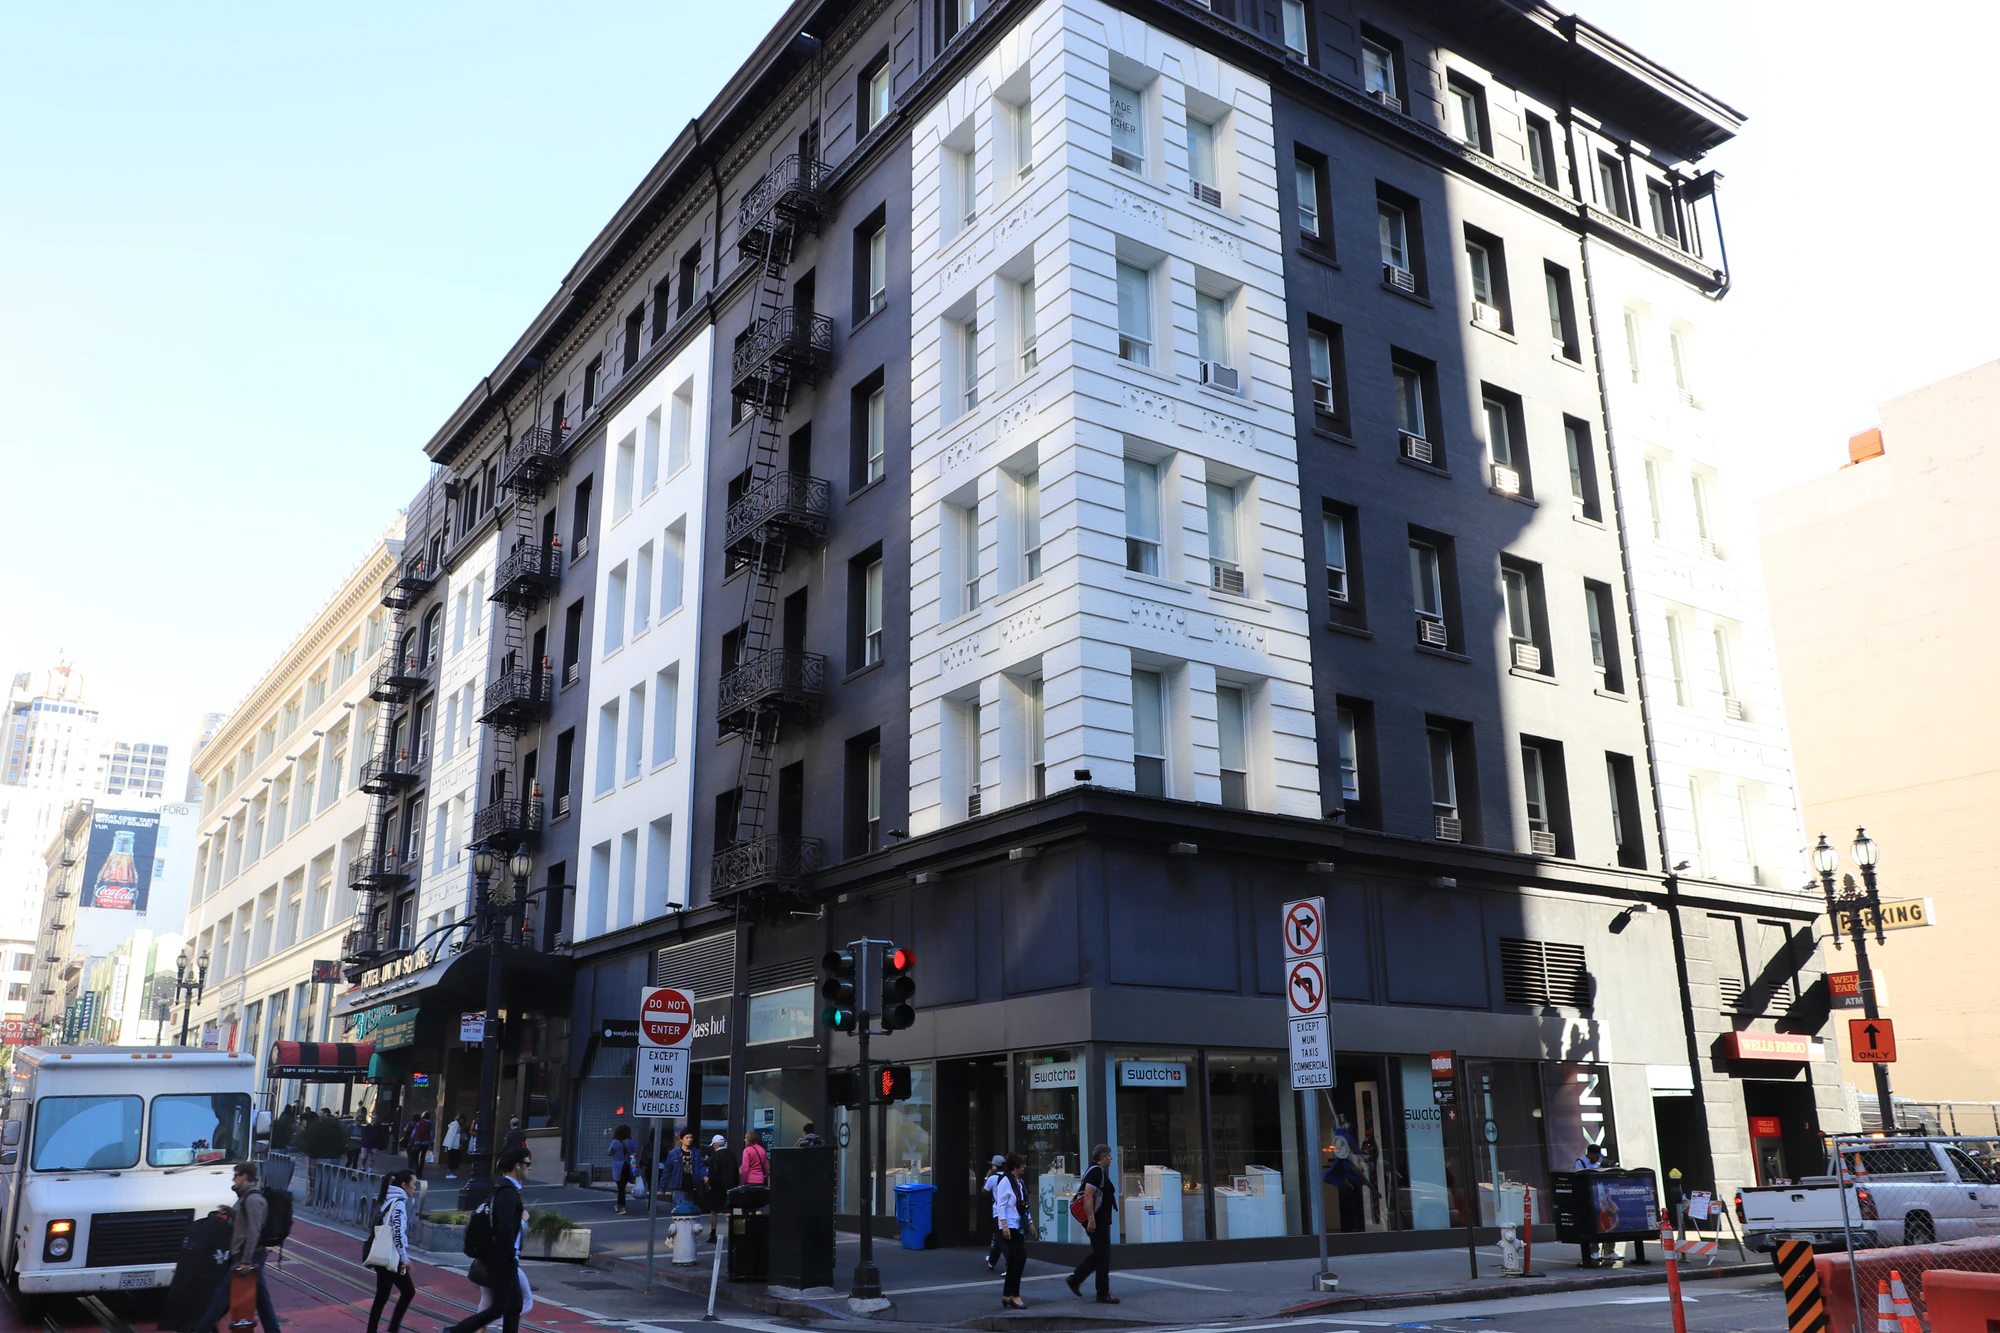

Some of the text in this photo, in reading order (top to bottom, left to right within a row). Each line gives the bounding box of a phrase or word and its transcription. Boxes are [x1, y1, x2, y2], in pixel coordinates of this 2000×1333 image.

[159, 805, 189, 815] FORD
[95, 812, 118, 820] GREAT
[95, 817, 126, 825] WITHOUT
[1840, 905, 1922, 929] PRKING
[361, 948, 432, 990] HOTEL UNION SQUARE
[1832, 974, 1860, 984] WELL
[1834, 984, 1859, 993] FAR
[649, 999, 685, 1010] DO NOT
[1845, 997, 1863, 1006] ATM
[75, 1000, 84, 1017] WINE
[651, 1024, 680, 1035] ENTER
[692, 1015, 726, 1039] lass hut
[1297, 1021, 1319, 1032] EXCEPT
[612, 1030, 634, 1038] sunglass
[1301, 1035, 1317, 1045] MUNI
[1741, 1039, 1806, 1054] WELLS FARGO
[649, 1051, 679, 1061] EXCEPT
[1301, 1048, 1319, 1058] TAXIS
[653, 1064, 673, 1074] MUNI
[1293, 1060, 1328, 1072] COMMERCIAL
[1034, 1068, 1069, 1083] swatch
[1127, 1067, 1173, 1080] swatch
[651, 1077, 674, 1087] TAXIS
[1297, 1073, 1327, 1085] VEHICLES
[638, 1089, 684, 1100] COMMERCIAL
[642, 1102, 680, 1113] VEHICLES
[1031, 1113, 1065, 1122] MECHANICAL
[1404, 1107, 1441, 1121] swatc
[1026, 1122, 1058, 1131] REVOLUTION
[1608, 1186, 1649, 1195] Reservations?
